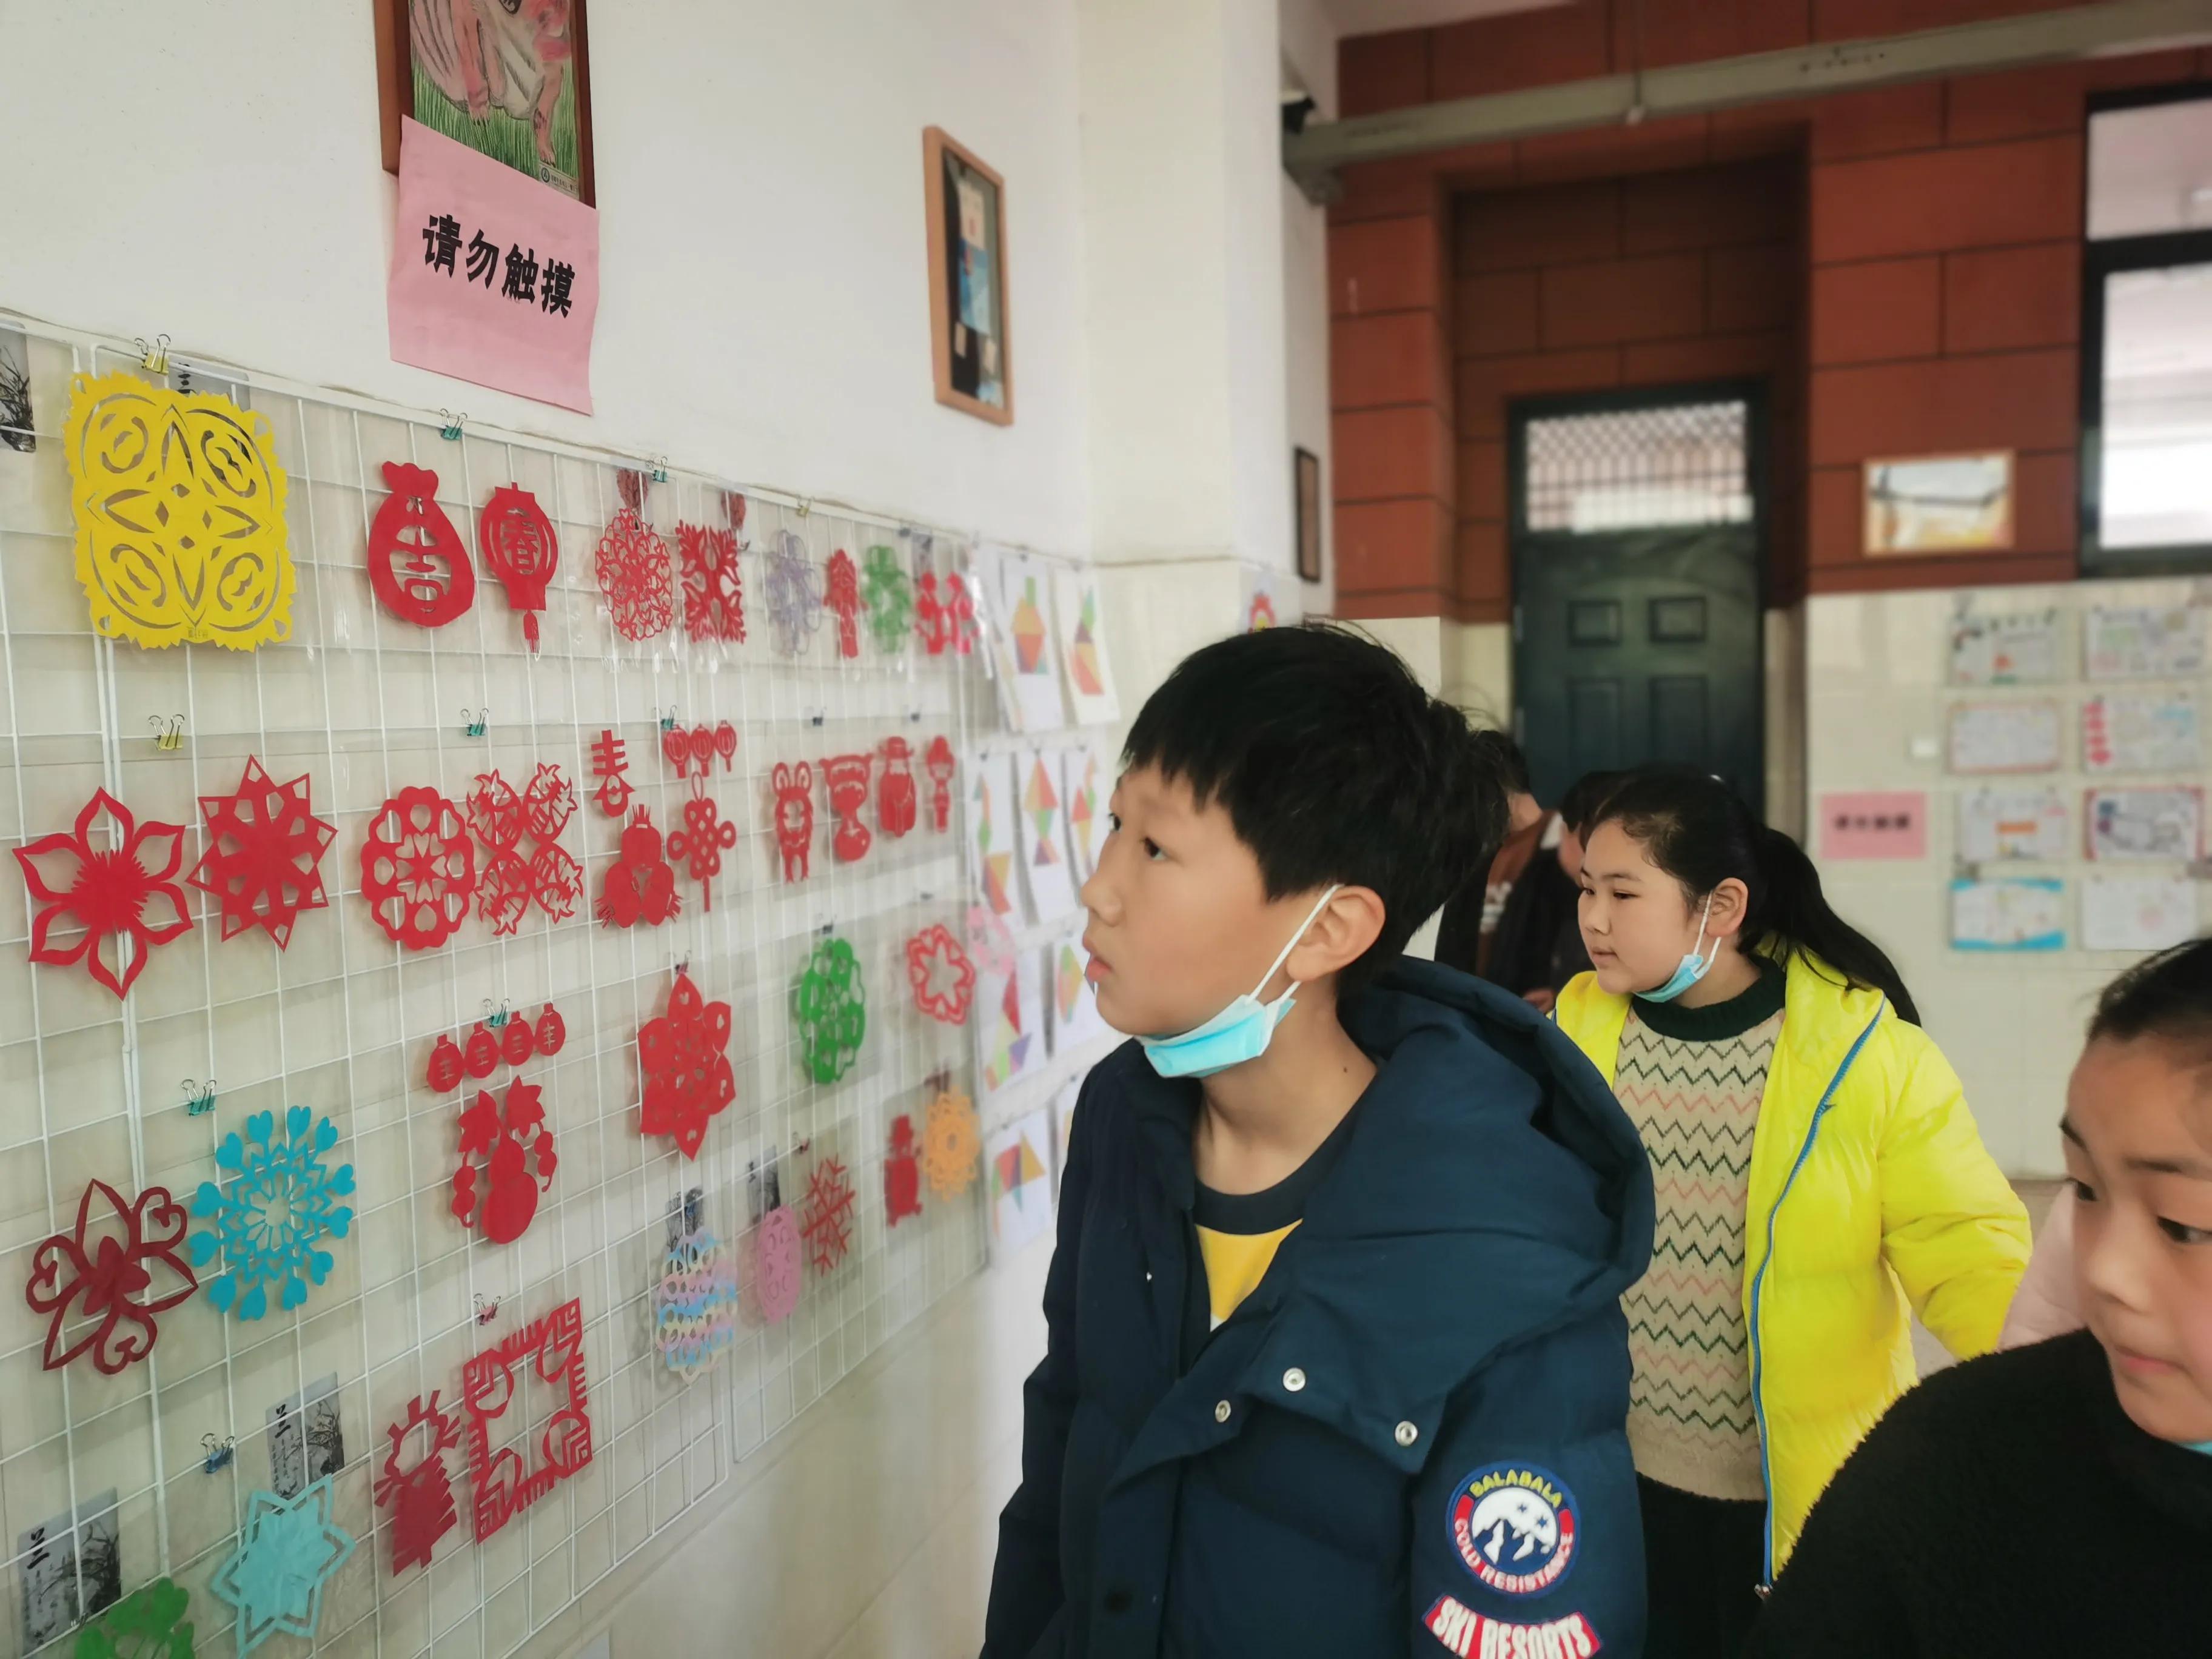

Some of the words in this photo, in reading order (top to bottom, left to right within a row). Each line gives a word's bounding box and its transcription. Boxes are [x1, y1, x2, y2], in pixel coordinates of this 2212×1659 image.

[423, 214, 575, 318] 请勿触摸
[1469, 1469, 1563, 1508] BALABALA
[1432, 1598, 1477, 1659] SKI
[1479, 1614, 1592, 1659] RESORTS
